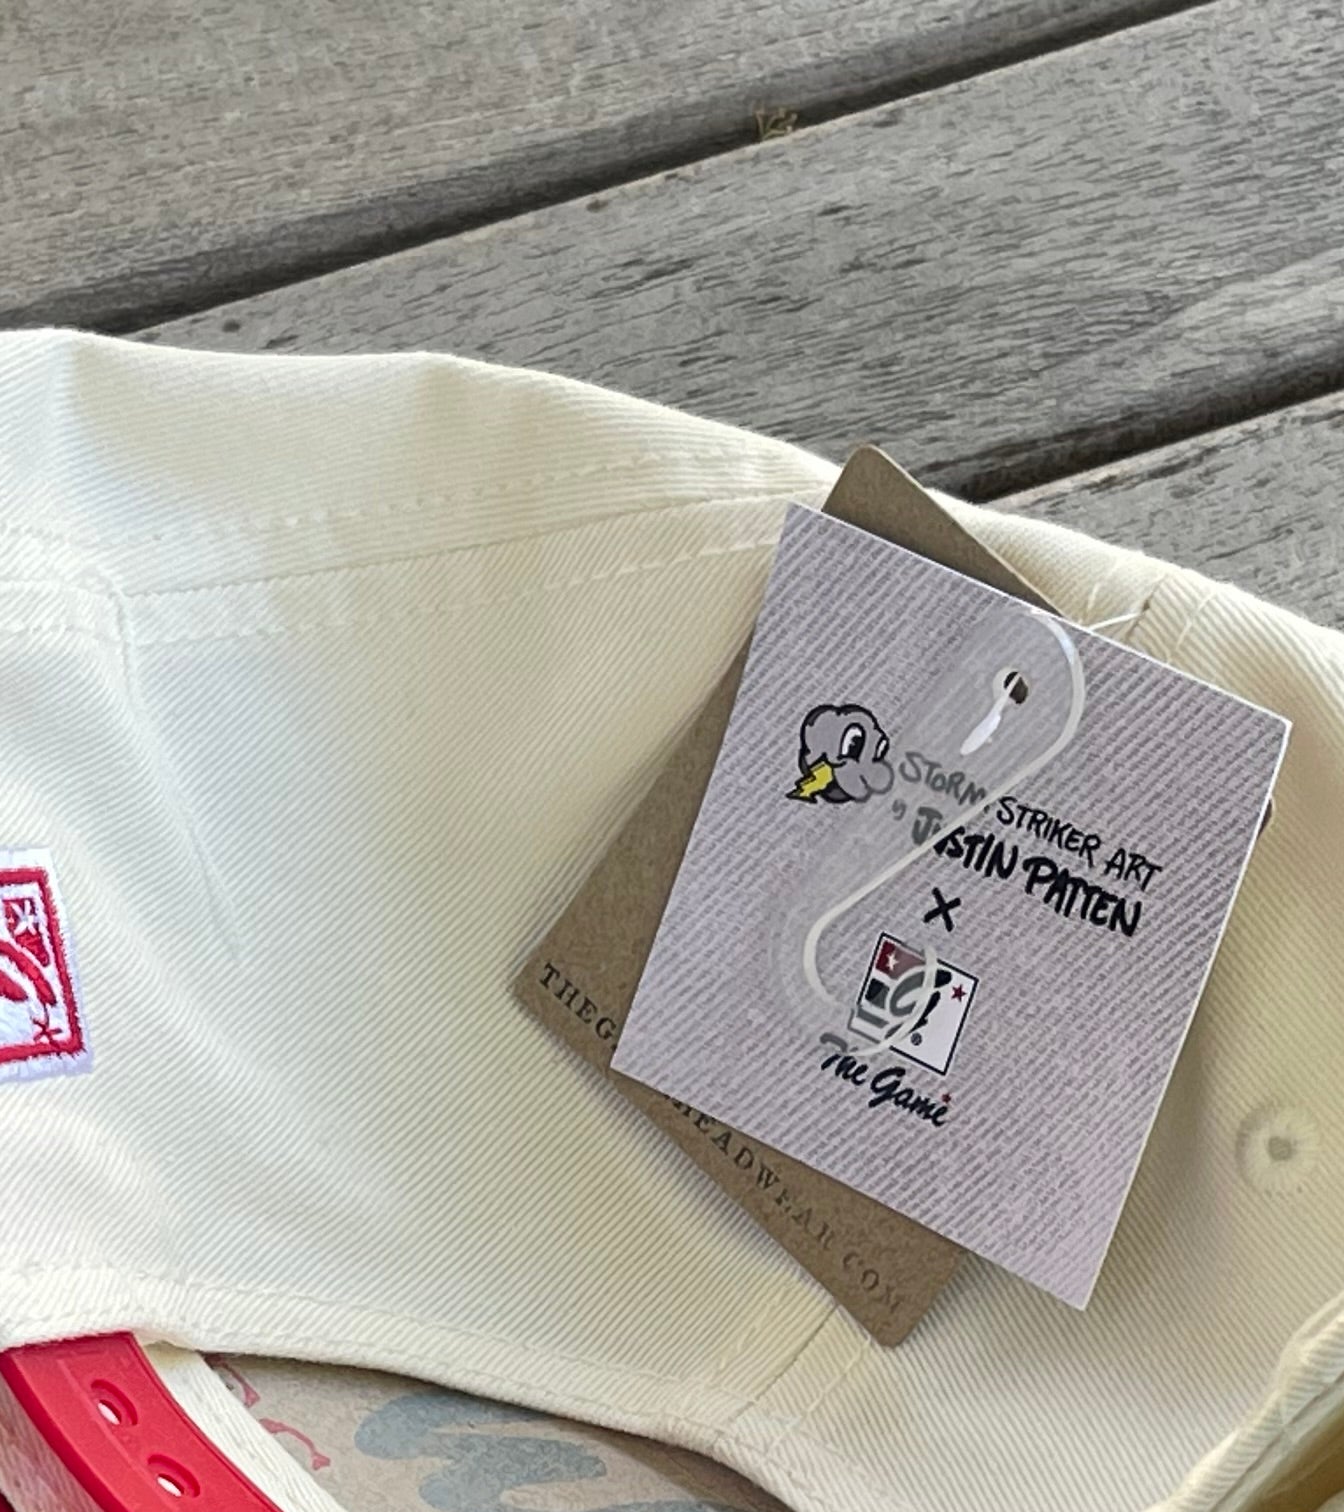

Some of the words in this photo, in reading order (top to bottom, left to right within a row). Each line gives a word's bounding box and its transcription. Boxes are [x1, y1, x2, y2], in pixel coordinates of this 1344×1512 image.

[899, 751, 990, 815] STORM
[995, 796, 1102, 869] STRIKER
[1103, 847, 1163, 893] ART
[911, 806, 1019, 880] JUSTIN
[1021, 856, 1143, 938] PATTEN
[867, 1066, 950, 1138] Game
